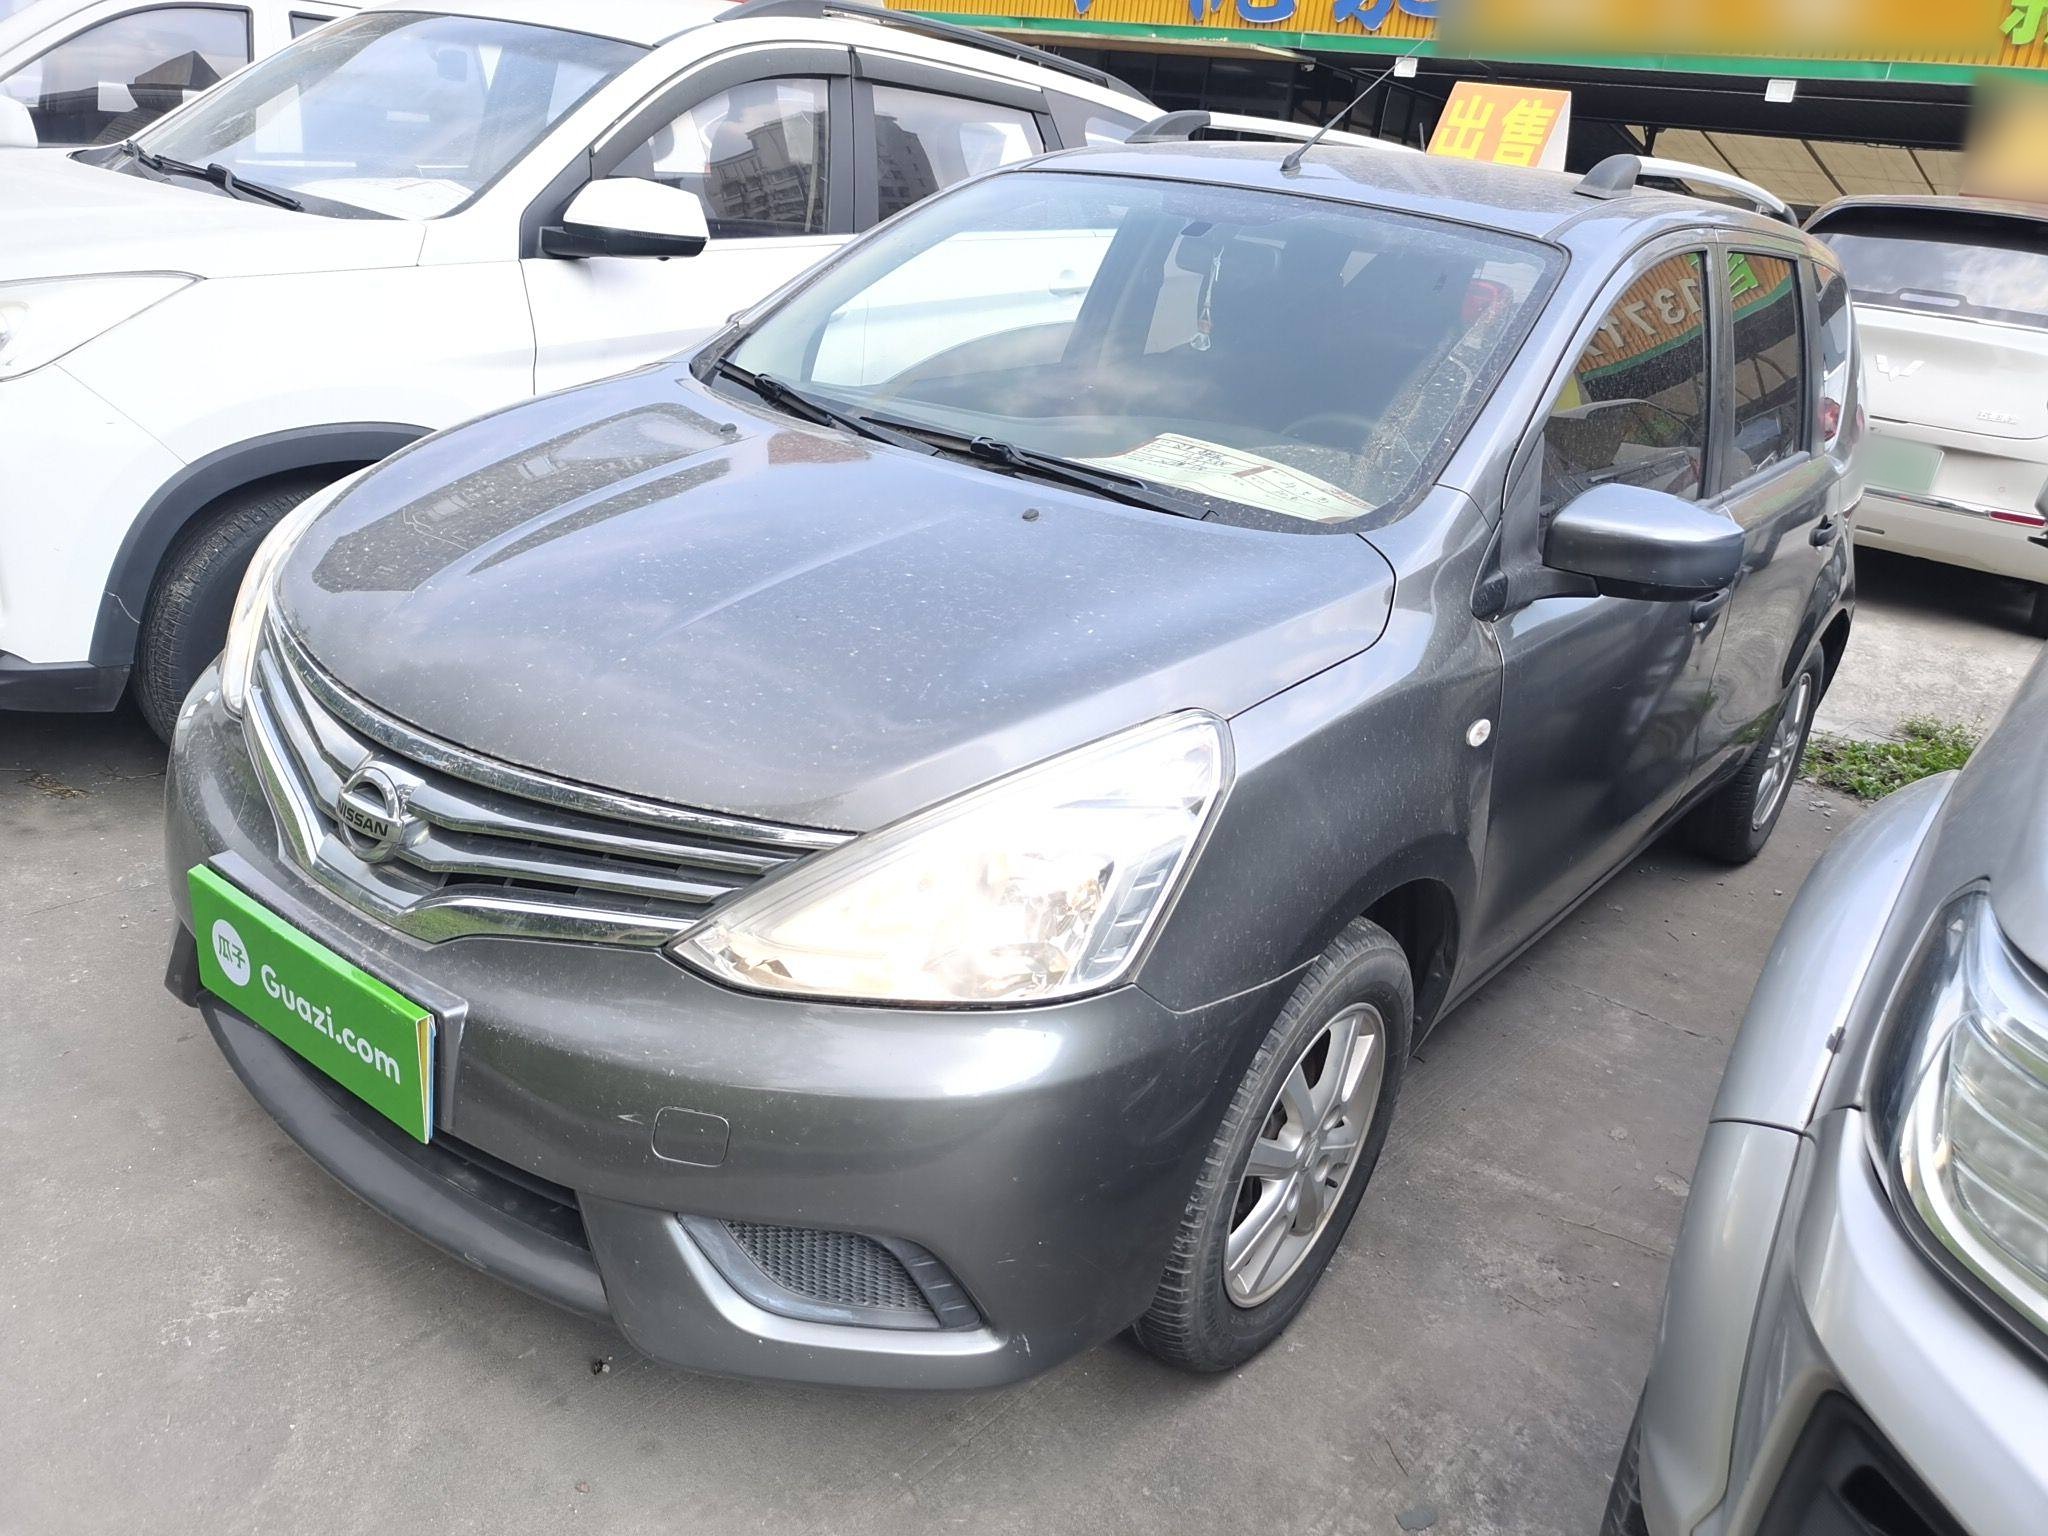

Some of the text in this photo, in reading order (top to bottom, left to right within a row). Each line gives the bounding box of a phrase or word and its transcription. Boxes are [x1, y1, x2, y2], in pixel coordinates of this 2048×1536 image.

[1433, 94, 1556, 166] 出售
[339, 803, 389, 837] NISSAN
[217, 933, 246, 969] 瓜子
[260, 963, 401, 1085] Guazi.com
